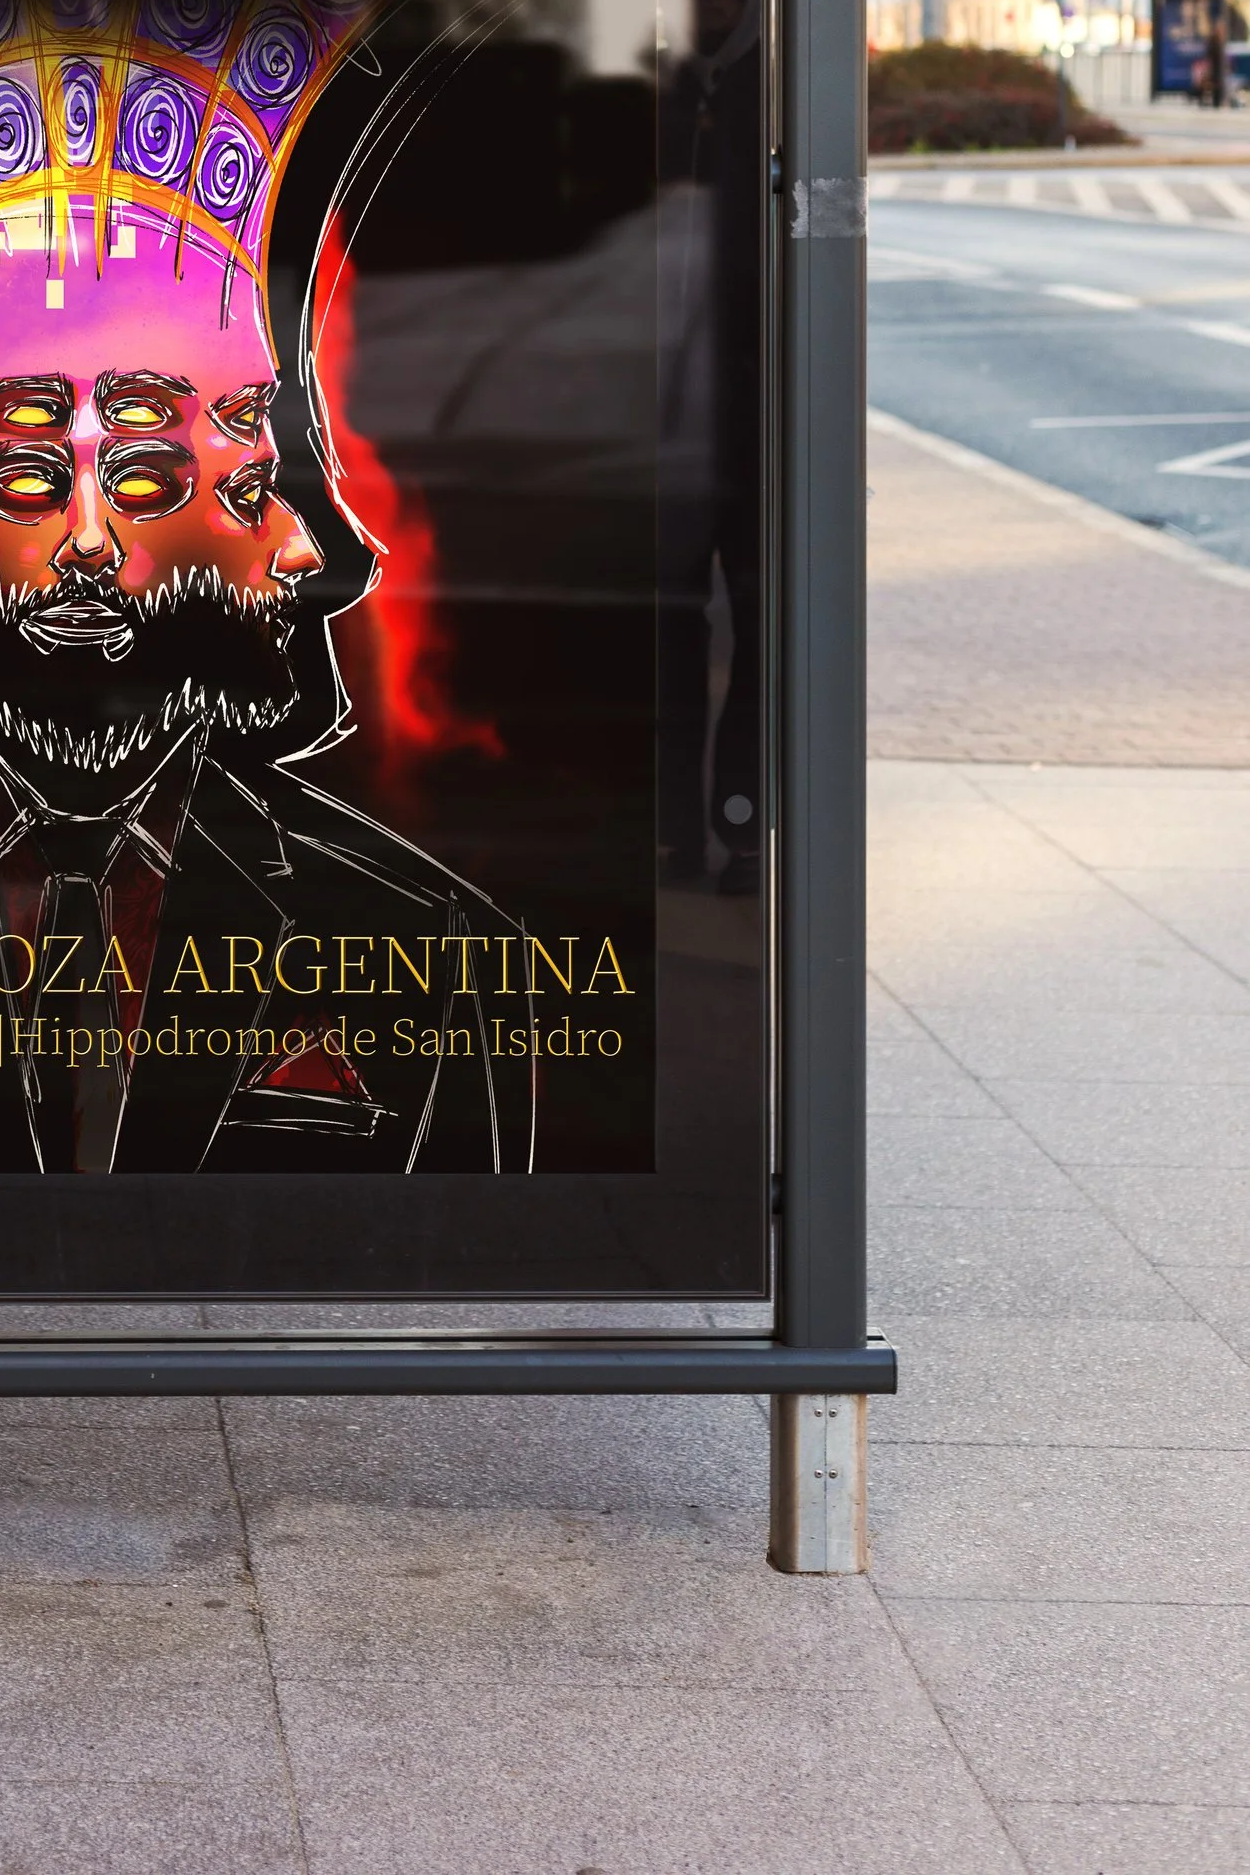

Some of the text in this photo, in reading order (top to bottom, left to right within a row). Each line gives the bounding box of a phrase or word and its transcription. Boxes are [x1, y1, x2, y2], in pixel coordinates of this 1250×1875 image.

[163, 933, 636, 995] ARGENTINA
[323, 1015, 381, 1056] de
[392, 1015, 475, 1056] San
[491, 1015, 625, 1056] Isidro
